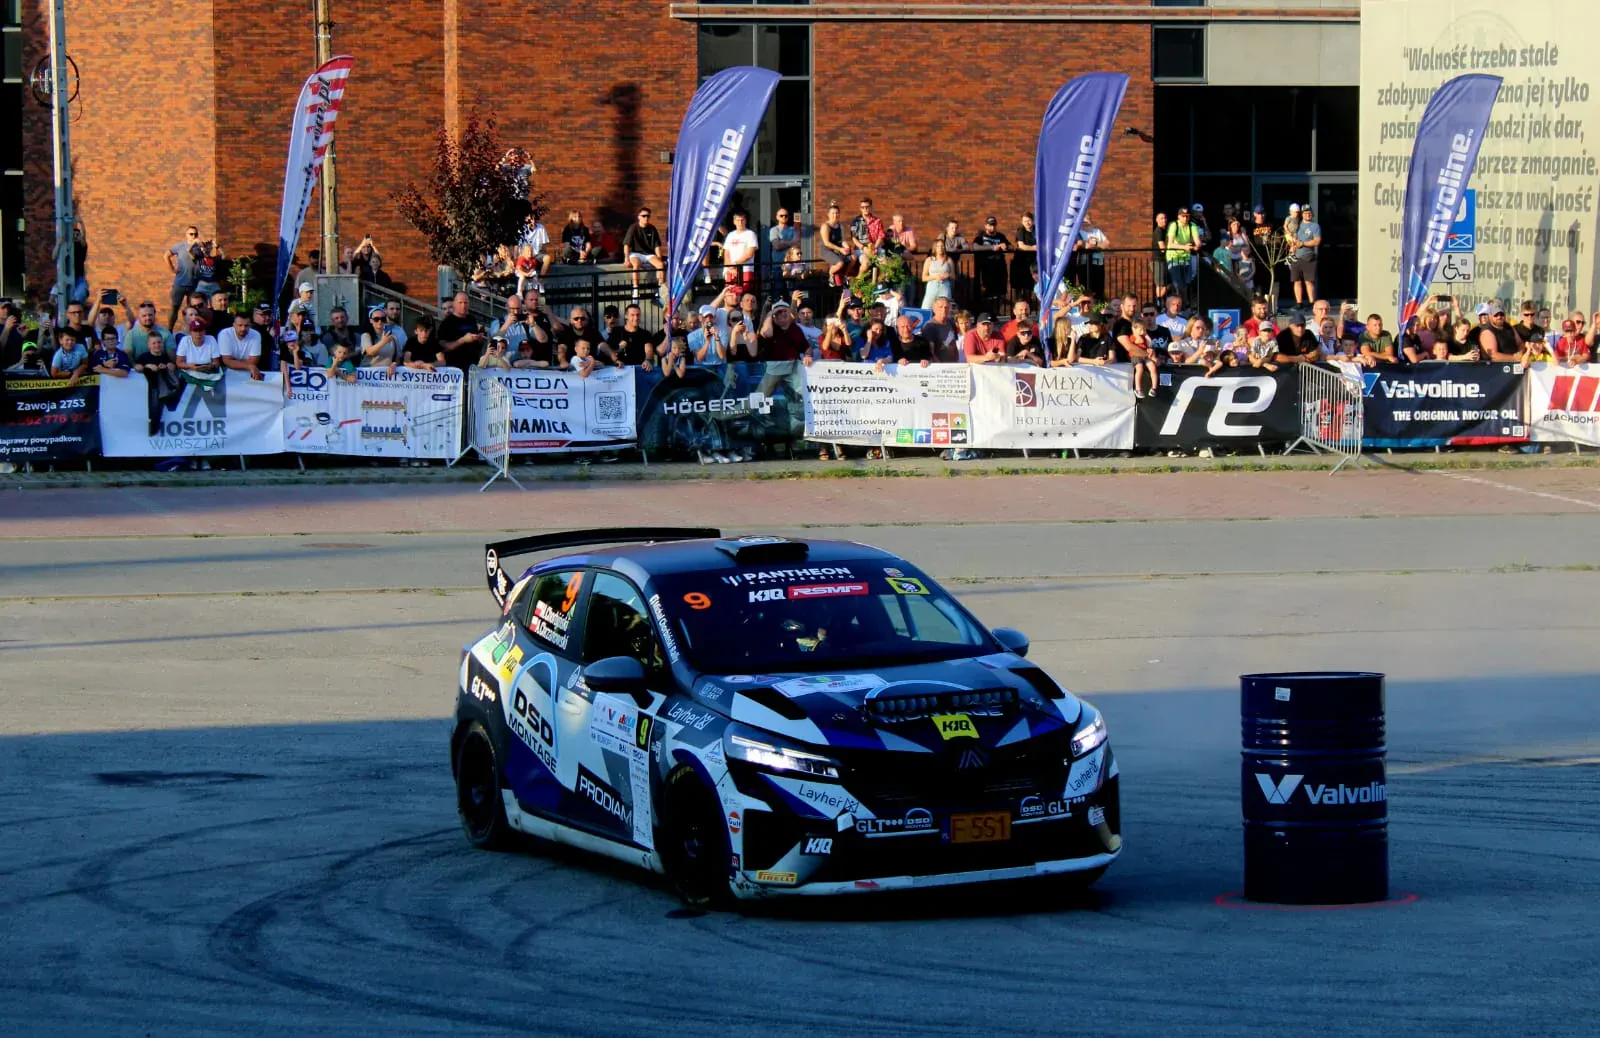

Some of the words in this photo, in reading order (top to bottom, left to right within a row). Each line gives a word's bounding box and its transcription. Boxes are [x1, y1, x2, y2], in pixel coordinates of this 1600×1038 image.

[1470, 43, 1516, 70] trzeba
[1519, 41, 1559, 67] stale
[1526, 76, 1545, 108] jej
[1548, 76, 1590, 109] tylko
[1527, 113, 1551, 144] jak
[1554, 113, 1585, 144] dar,
[1521, 148, 1599, 181] zmaganie.
[1374, 182, 1405, 212] Cały
[1506, 191, 1522, 210] za
[1527, 185, 1592, 212] wolność
[1514, 259, 1528, 287] tę
[402, 370, 462, 384] SYSTEMÓW
[1040, 373, 1094, 390] MŁYN
[17, 400, 57, 413] Zawoja
[59, 399, 86, 409] 2753
[663, 396, 749, 415] HÖGERT
[1039, 392, 1091, 409] JACKA
[812, 408, 848, 416] koparki
[1016, 416, 1056, 425] HOTEL
[1072, 416, 1092, 425] SPA
[1393, 411, 1411, 421] THE
[1413, 410, 1460, 421] ORIGINAL
[1462, 410, 1498, 420] MOTOR
[1501, 409, 1519, 420] OIL
[150, 437, 227, 450] WARSZTAT
[743, 567, 852, 580] PANTHEON
[561, 571, 582, 612] 9
[792, 585, 864, 596] RSMP
[683, 592, 711, 610] 9
[513, 687, 554, 748] DSD
[667, 701, 699, 727] Layher
[640, 717, 650, 746] 9
[508, 713, 558, 774] MONTAGE
[1069, 764, 1094, 792] Layher
[579, 774, 633, 828] PRODIAM
[798, 783, 844, 808] Layher
[1048, 799, 1071, 815] GLT
[728, 816, 742, 828] Gulf
[855, 819, 885, 833] GLT
[906, 817, 930, 825] DSD
[756, 871, 797, 883] PIRELLI
